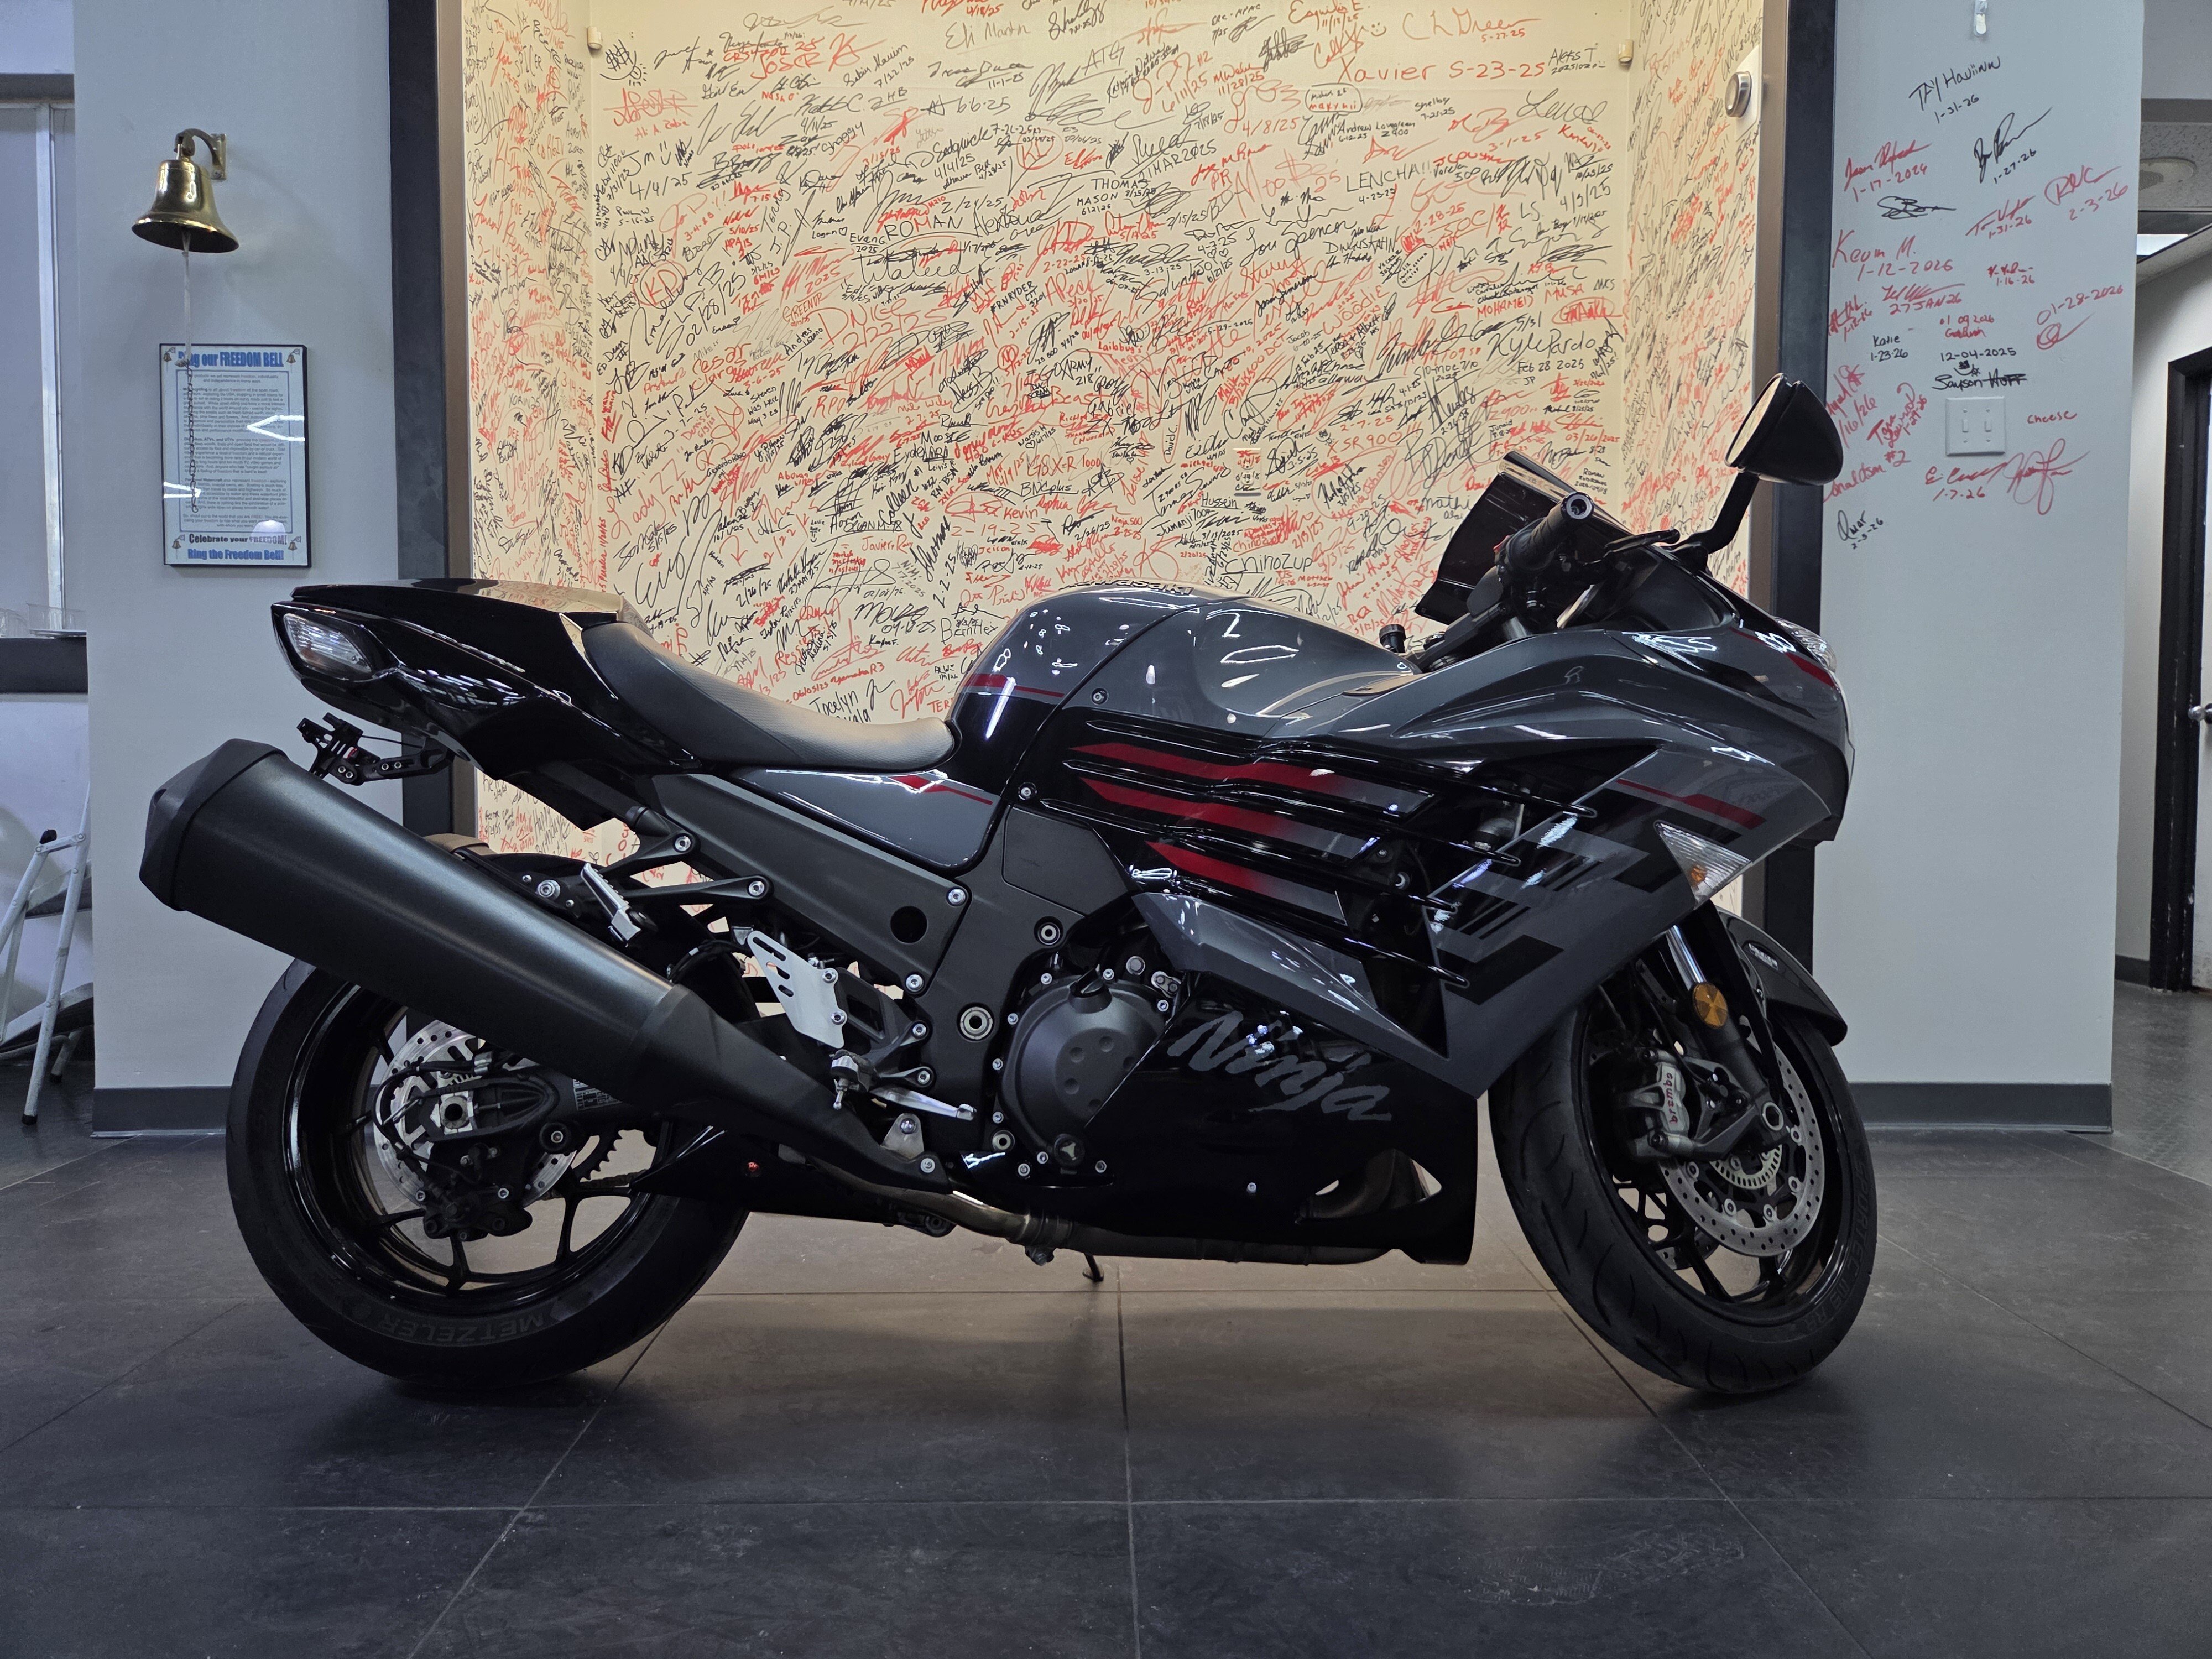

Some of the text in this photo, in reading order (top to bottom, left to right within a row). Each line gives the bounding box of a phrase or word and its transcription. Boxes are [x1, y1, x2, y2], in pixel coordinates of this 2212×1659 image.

[1338, 56, 1437, 83] Xavier
[1934, 94, 1980, 124] 1-31-26
[1243, 117, 1301, 138] 4/8/25
[1338, 119, 1372, 133] Andrew
[935, 153, 975, 179] 4/4/25
[1993, 148, 2037, 185] 1-27-26
[630, 172, 692, 200] 4/4/25
[1091, 178, 1150, 190] THOMAS
[1077, 191, 1118, 207] MASON
[2069, 182, 2128, 221] 2-3-26
[812, 230, 838, 239] Logan
[884, 216, 963, 242] ROMAN
[856, 245, 878, 253] 2025
[1896, 235, 1917, 260] M.
[1857, 258, 1954, 282] 1-12-2026
[1543, 283, 1585, 304] MUSA
[2037, 285, 2124, 326] 01-28-2026
[1973, 314, 1995, 324] 2026
[785, 327, 813, 356] Andres
[1548, 328, 1596, 359] Pardo
[1873, 335, 1901, 348] Katie
[178, 351, 284, 368] Rng our FREEDOM BELL
[693, 345, 713, 361] Mike
[1940, 347, 2017, 362] 12-04-2025
[1517, 359, 1585, 374] Feb 28 2025
[1074, 373, 1094, 385] 218
[1522, 376, 1536, 385] JP
[750, 387, 776, 404] Steven
[1339, 415, 1394, 432] 2-7-25
[1327, 435, 1365, 458] XSR
[1082, 454, 1103, 468] 1000
[1884, 450, 1912, 468] #2
[1201, 492, 1239, 510] Hussein
[1003, 506, 1039, 520] Kevin
[189, 533, 228, 544] Celebrate
[249, 534, 288, 545] FREEDOM!
[187, 548, 284, 561] Ring the Freedom Bell!
[1167, 1010, 1392, 1121] Ninja
[1663, 1072, 1678, 1124] brembo
[377, 1312, 545, 1343] METZELER
